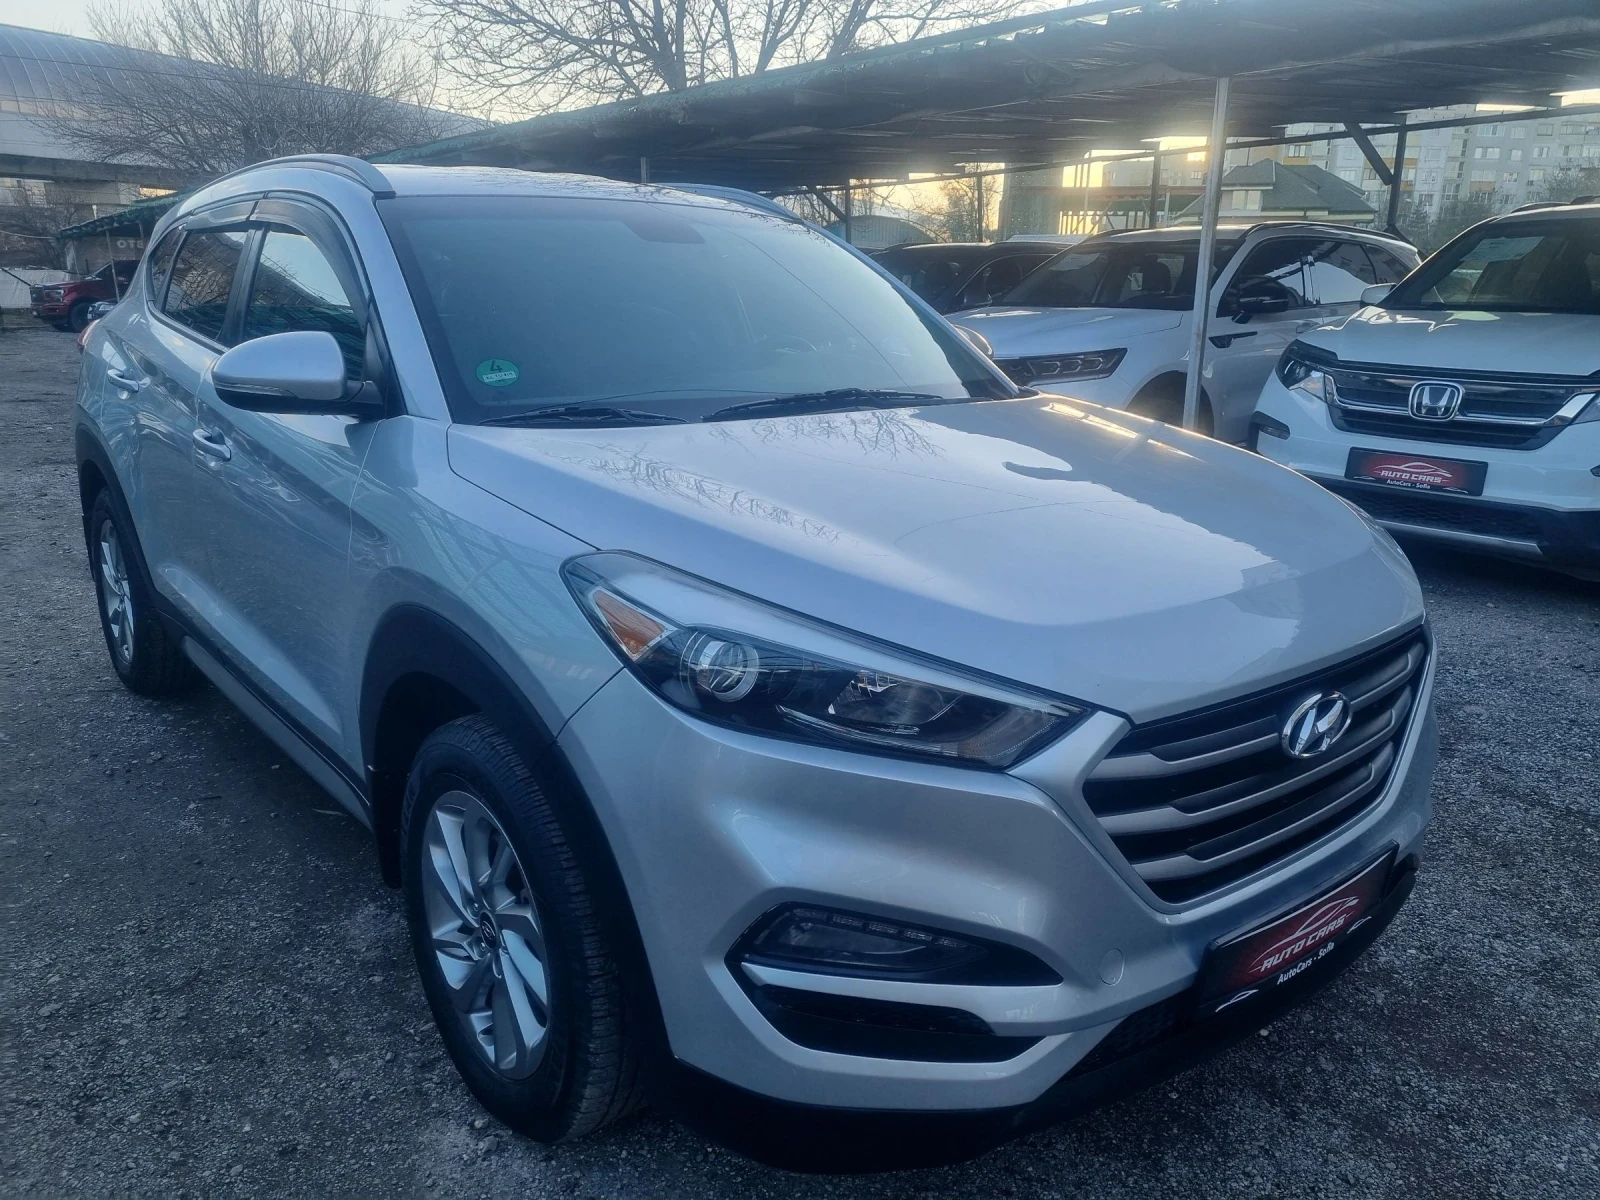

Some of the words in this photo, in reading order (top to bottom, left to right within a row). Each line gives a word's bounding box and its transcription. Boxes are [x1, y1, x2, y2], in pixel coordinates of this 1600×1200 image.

[490, 360, 503, 372] 4
[1380, 470, 1410, 479] AUTO
[1411, 474, 1442, 483] CARS
[1386, 479, 1411, 487] AutoCars
[1260, 938, 1307, 972] AUTO
[1305, 913, 1347, 947] CARS
[1276, 958, 1313, 985] AutoCars
[1317, 941, 1335, 960] Sofia
